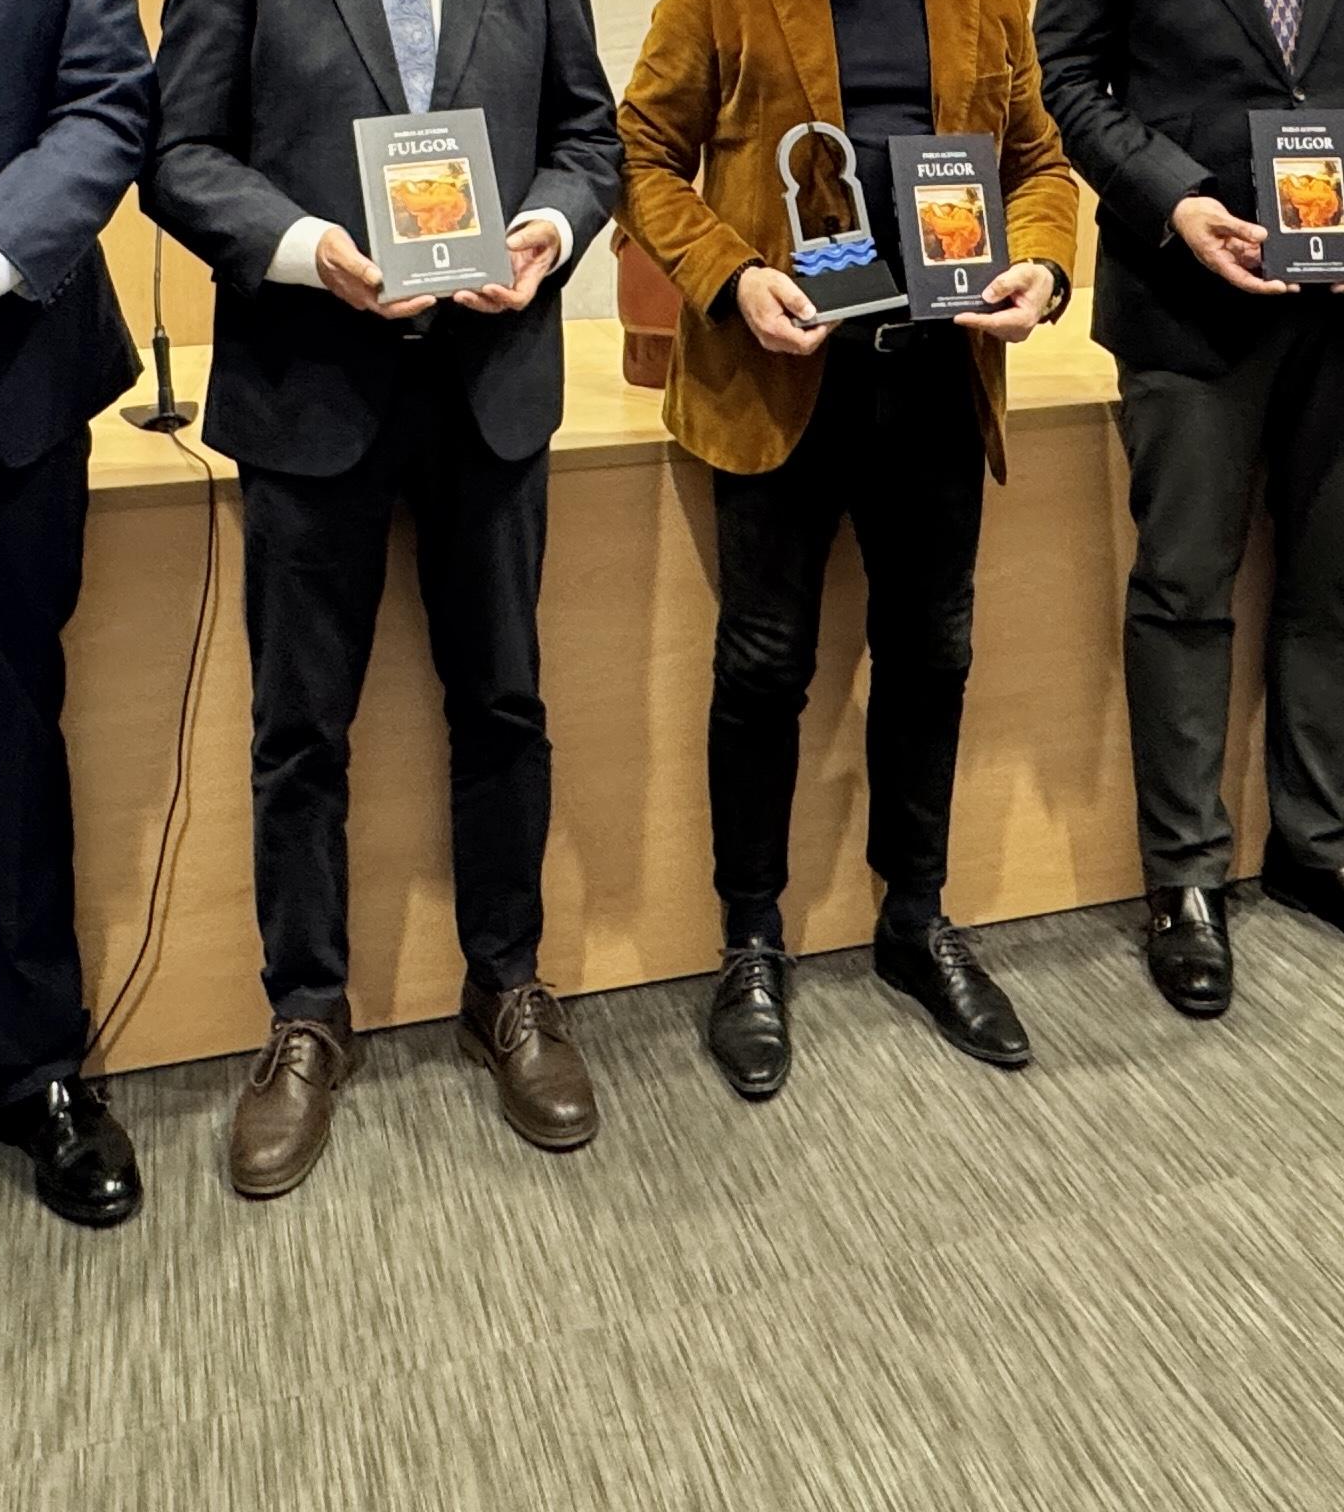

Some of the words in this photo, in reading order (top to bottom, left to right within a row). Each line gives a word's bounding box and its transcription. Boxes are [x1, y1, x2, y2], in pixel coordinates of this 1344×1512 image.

[387, 138, 459, 156] FULGOR
[1277, 137, 1334, 149] FULGOR
[917, 162, 975, 178] FULGOR
